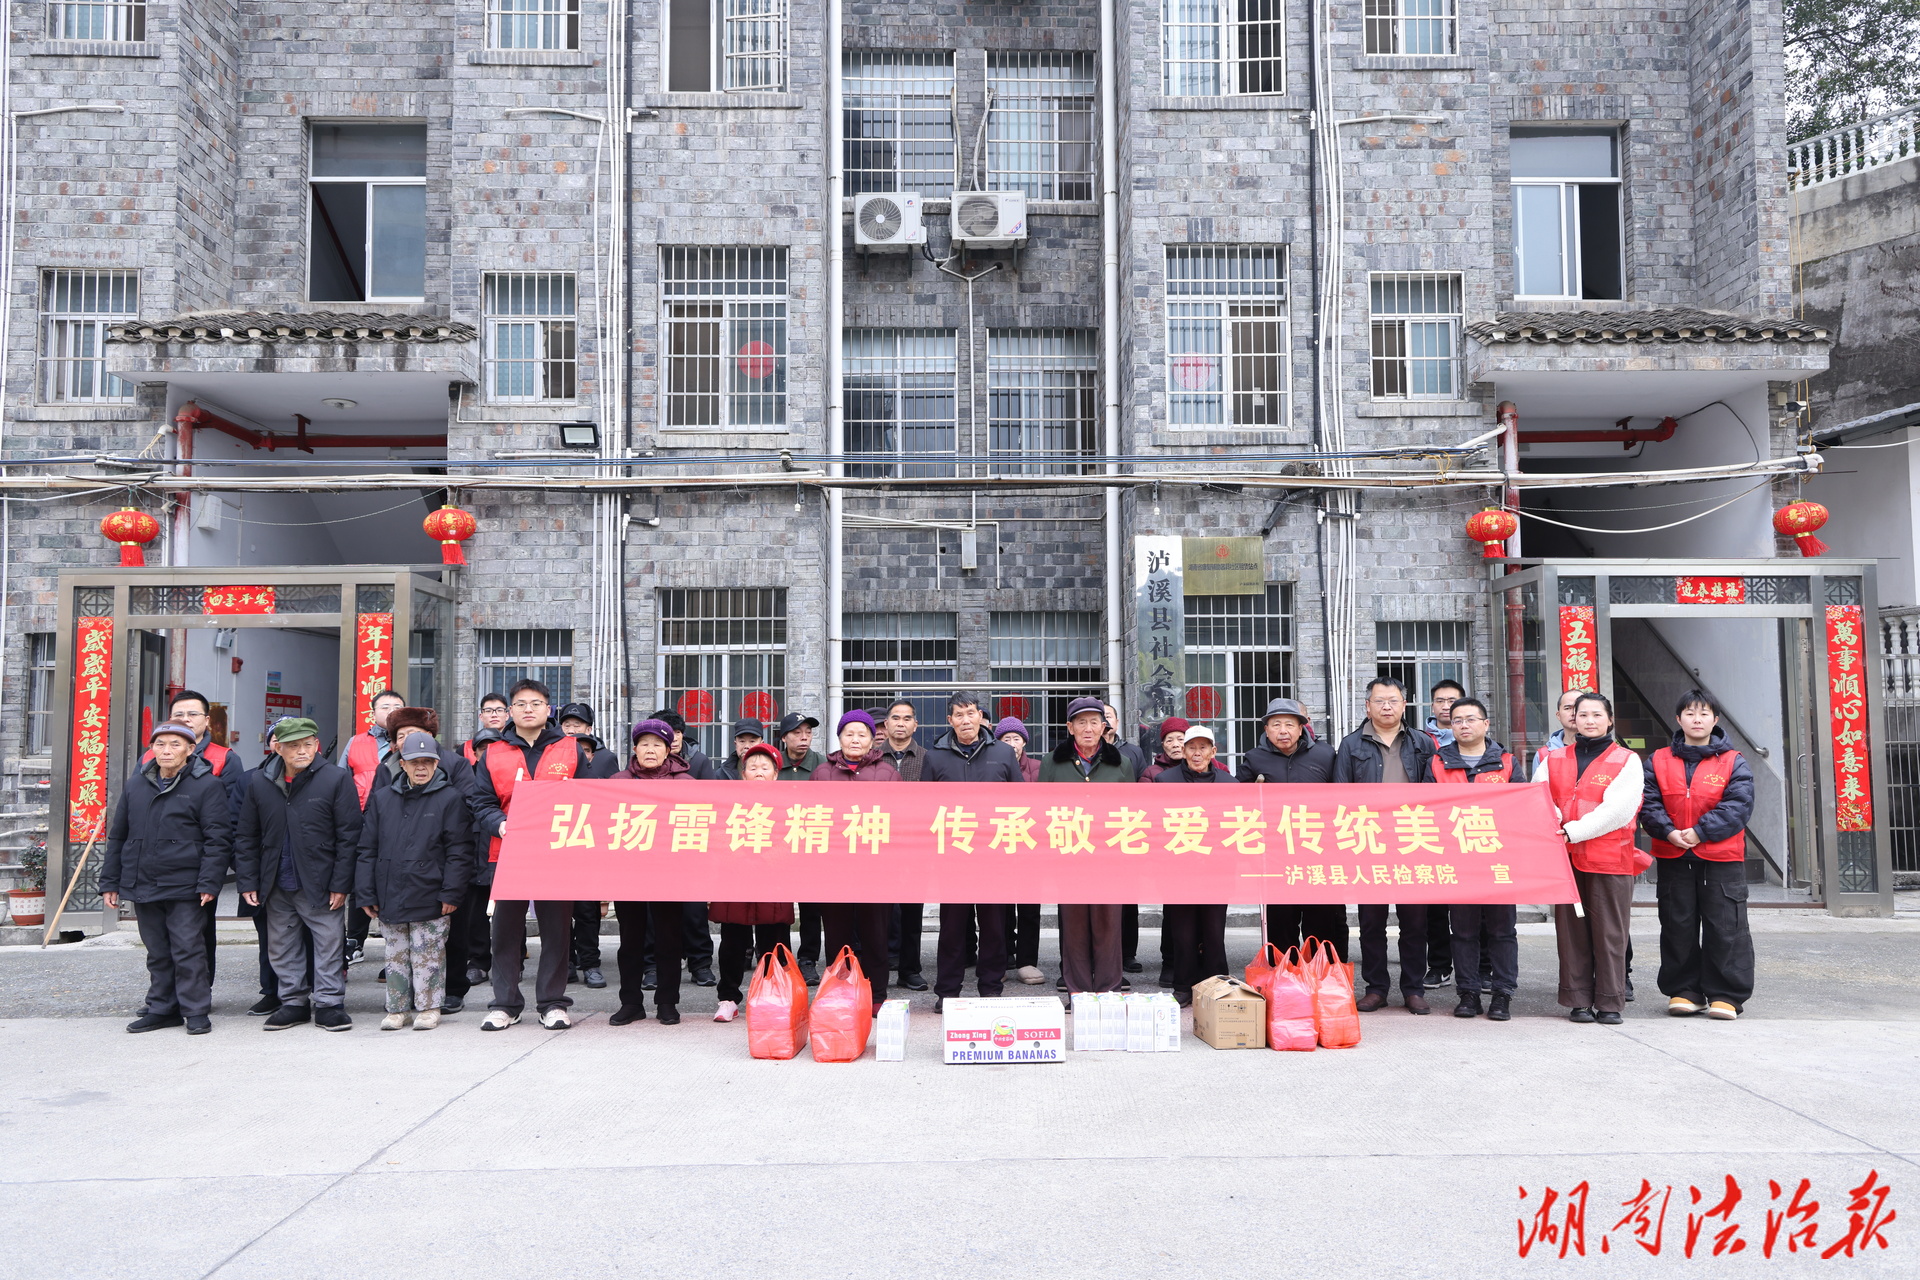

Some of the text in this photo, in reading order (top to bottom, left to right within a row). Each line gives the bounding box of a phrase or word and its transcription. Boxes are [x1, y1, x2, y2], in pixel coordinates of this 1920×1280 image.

[1681, 582, 1740, 598] 迎春接福
[209, 593, 270, 607] 四季平安
[550, 803, 1504, 856] 弘扬雷锋精神 传承敬老爱老传统美德
[1490, 863, 1514, 885] 宣
[950, 1032, 970, 1040] Zhong
[972, 1031, 987, 1040] Xing
[1024, 1031, 1056, 1039] SOFIA
[952, 1049, 1057, 1061] PREMIUM BANANAS
